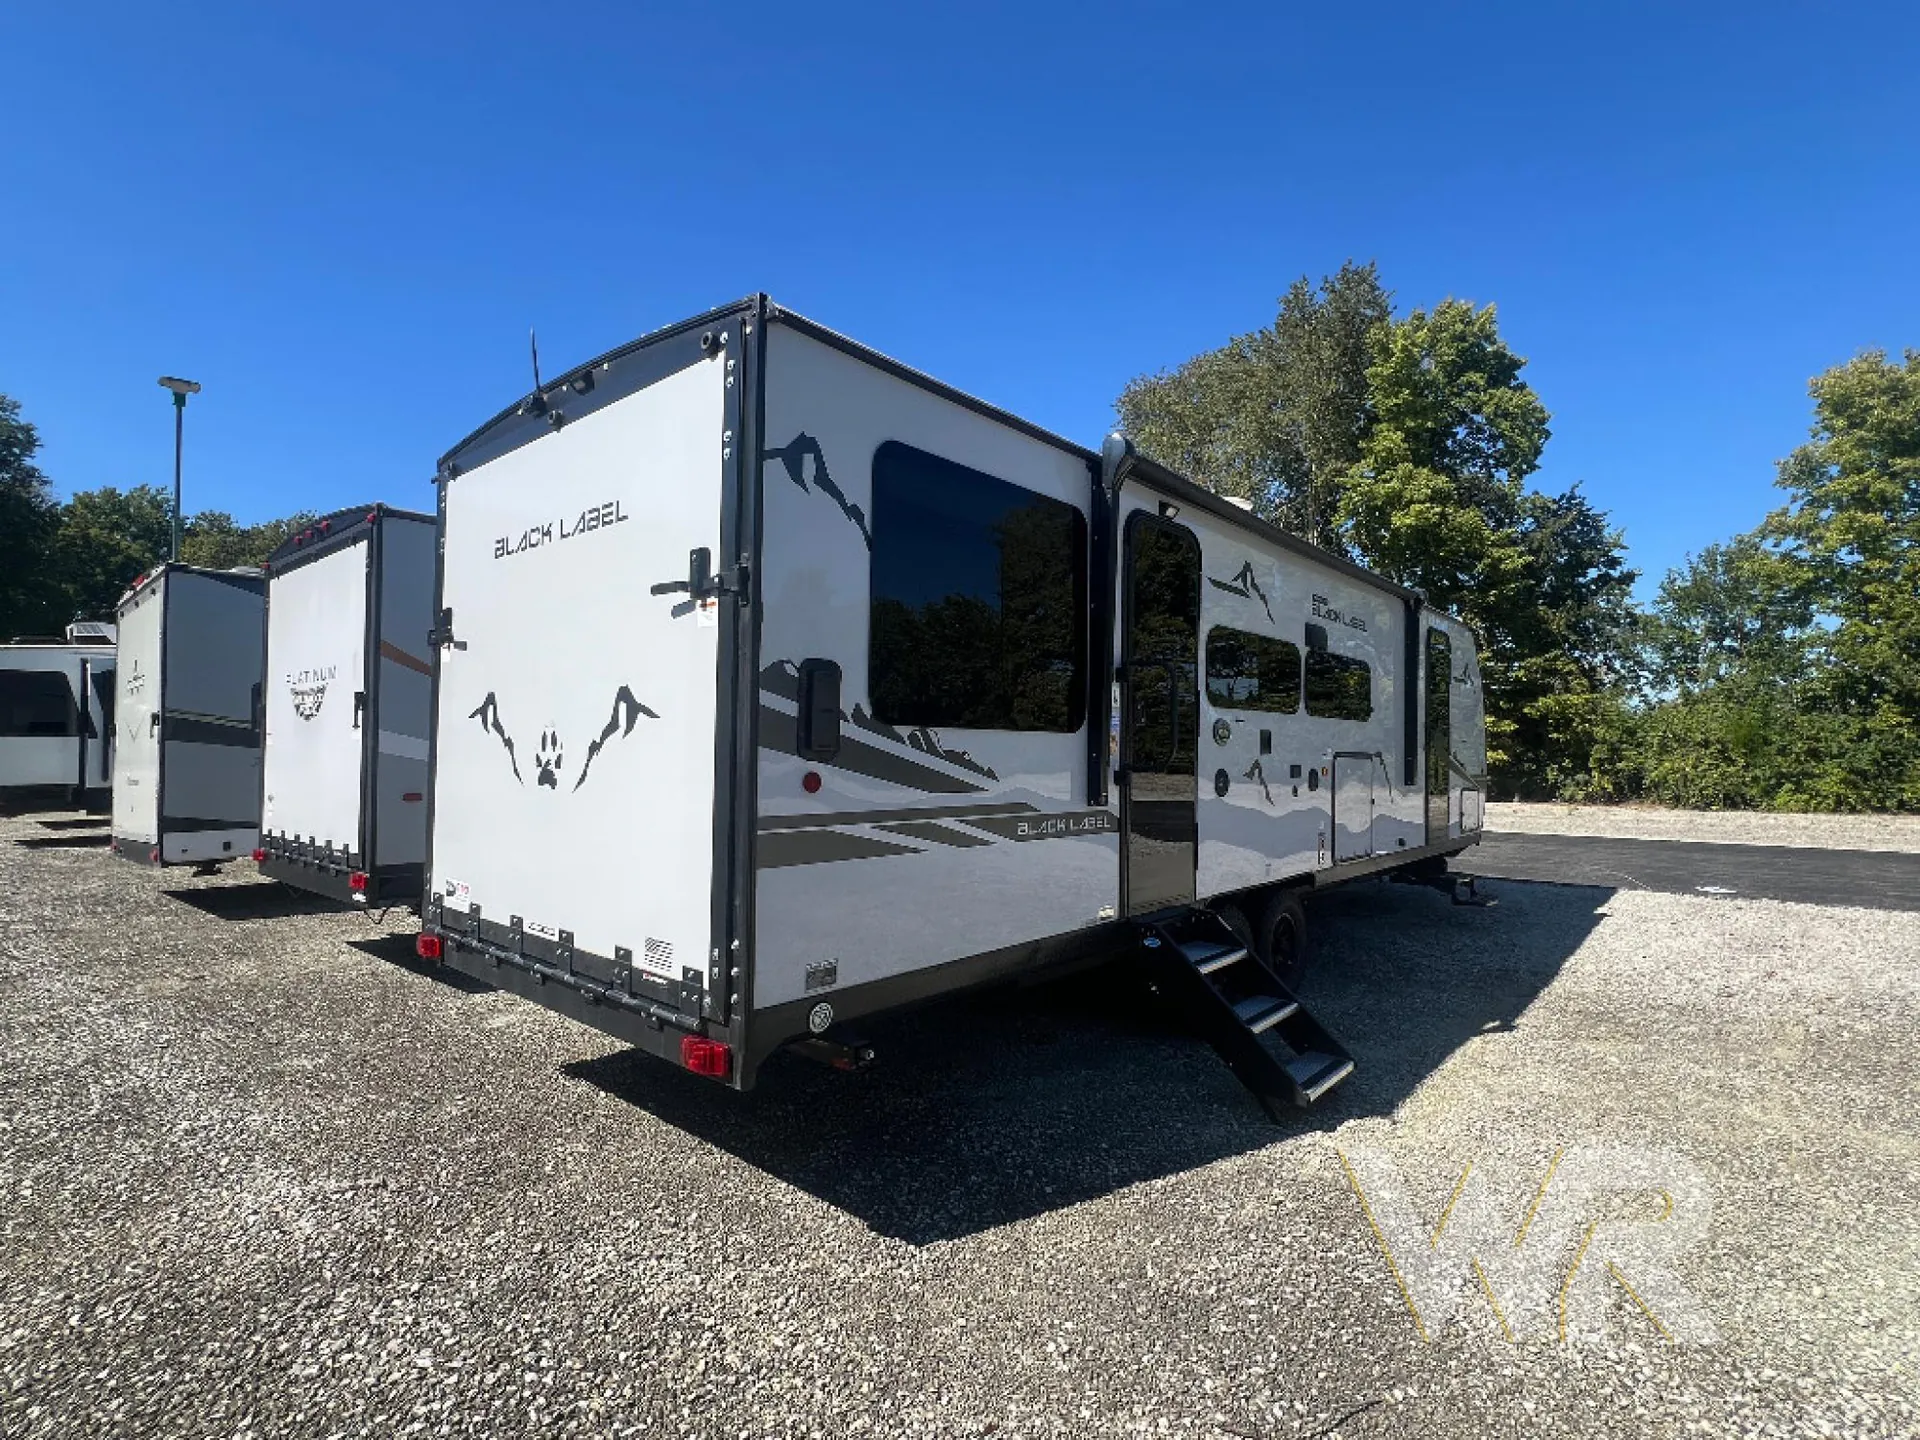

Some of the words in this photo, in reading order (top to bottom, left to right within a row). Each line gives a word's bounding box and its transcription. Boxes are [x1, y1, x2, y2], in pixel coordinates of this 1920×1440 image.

[494, 522, 553, 560] BLACK
[559, 500, 630, 539] LABEL
[286, 664, 337, 685] PLATINUM
[1017, 819, 1066, 836] BLACK
[1069, 815, 1112, 831] LABEL
